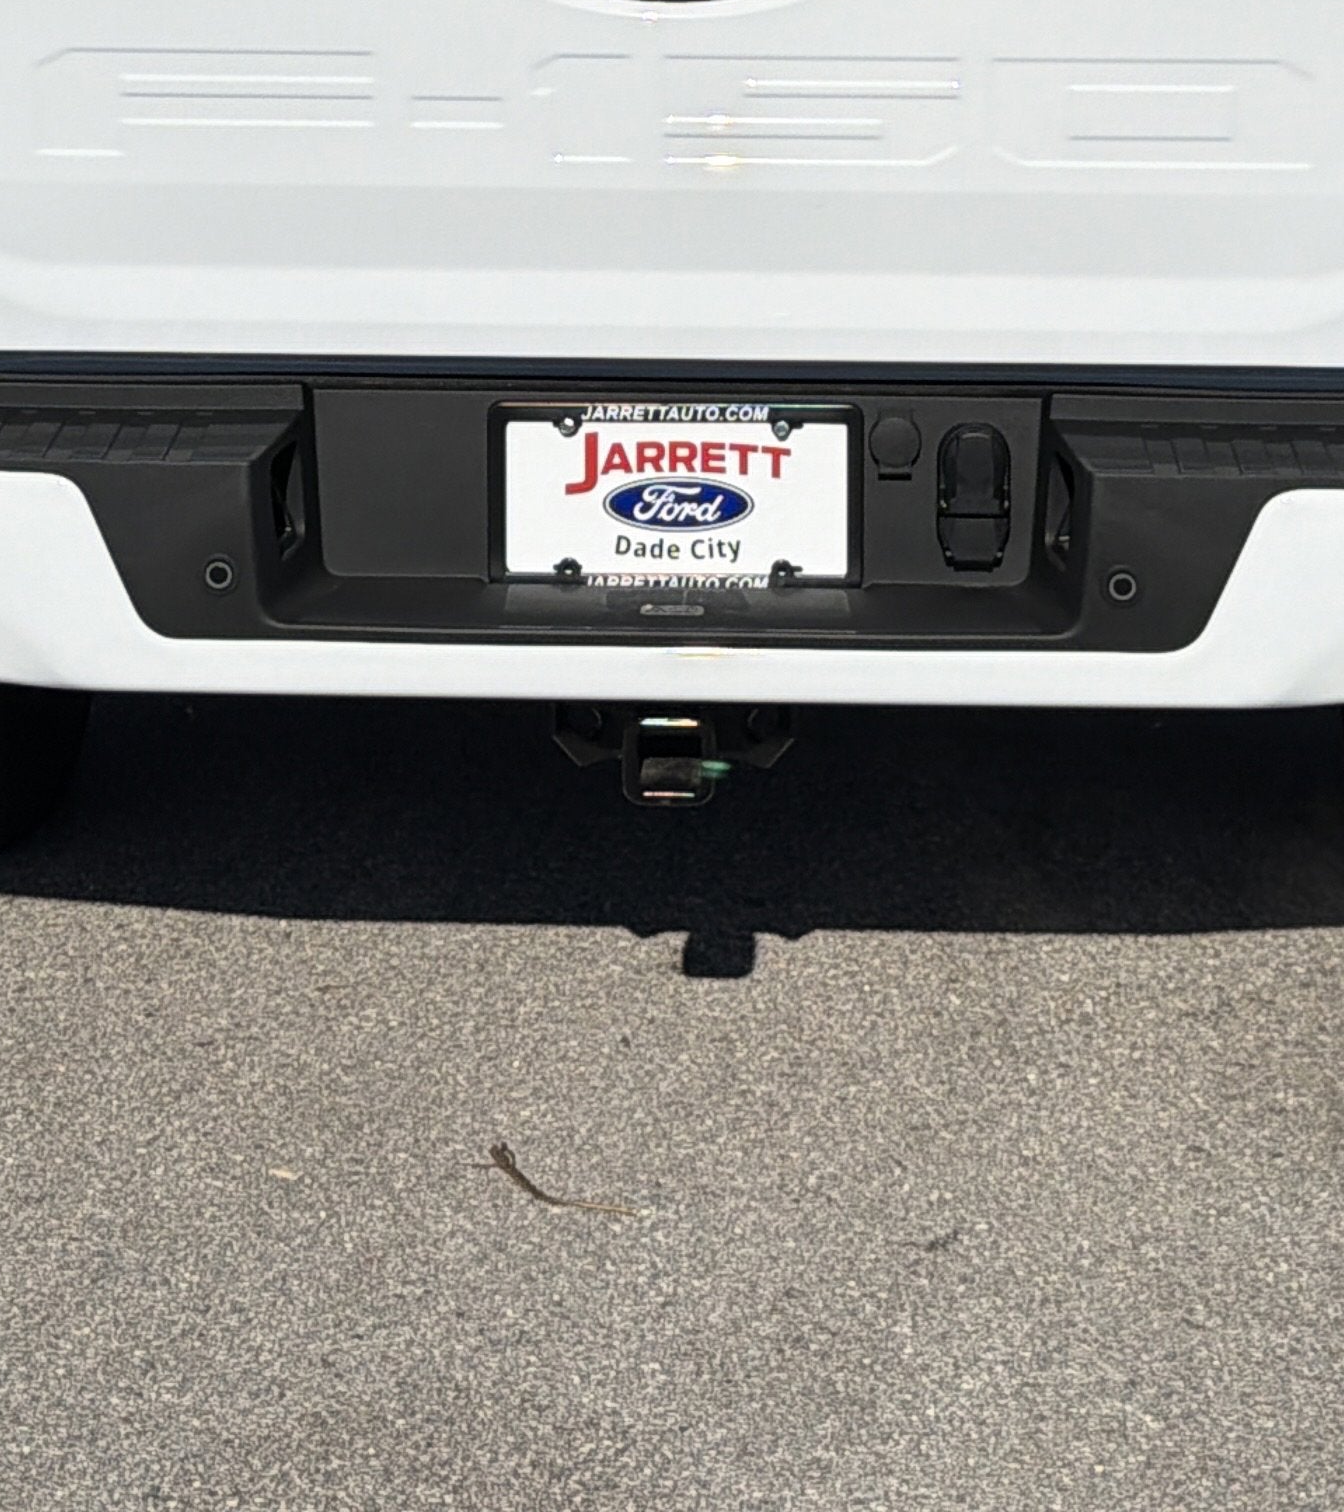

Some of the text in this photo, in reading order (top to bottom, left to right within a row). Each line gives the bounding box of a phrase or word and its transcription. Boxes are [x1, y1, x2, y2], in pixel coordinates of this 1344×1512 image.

[581, 404, 770, 422] JARRETTAUTO.COM
[564, 431, 792, 495] JARRETT
[632, 484, 725, 522] Ford
[614, 535, 742, 563] Dade City
